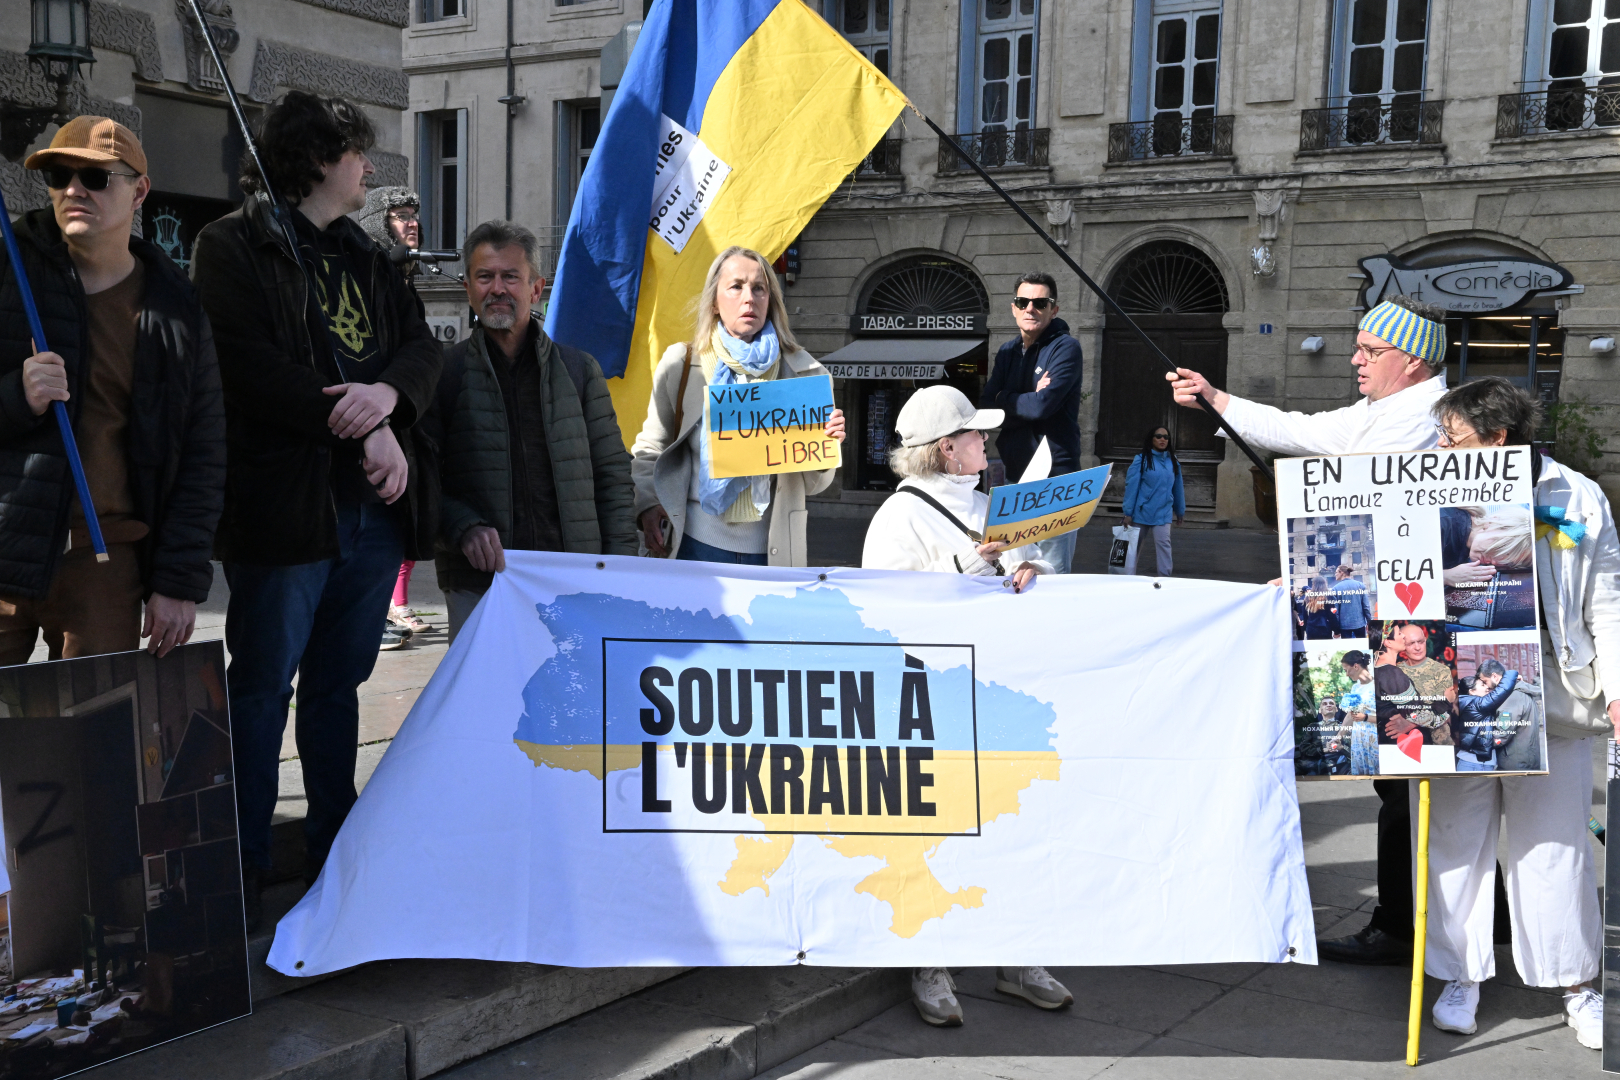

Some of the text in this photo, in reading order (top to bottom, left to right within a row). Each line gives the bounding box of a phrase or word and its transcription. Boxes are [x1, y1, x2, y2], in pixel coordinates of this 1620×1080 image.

[649, 184, 682, 232] pour
[664, 159, 719, 245] l'Ukraine
[861, 316, 905, 329] TABAC
[917, 315, 974, 329] PRESSE
[857, 366, 870, 377] DE
[875, 366, 887, 377] LA
[891, 366, 936, 378] COMEDIE
[1303, 450, 1522, 486] EN UKRAINE
[1405, 482, 1514, 506] ressemble
[1398, 516, 1410, 537] à
[1377, 558, 1434, 582] CELA
[639, 652, 935, 741] SOUTIEN À
[641, 741, 937, 816] L'UKRAINE
